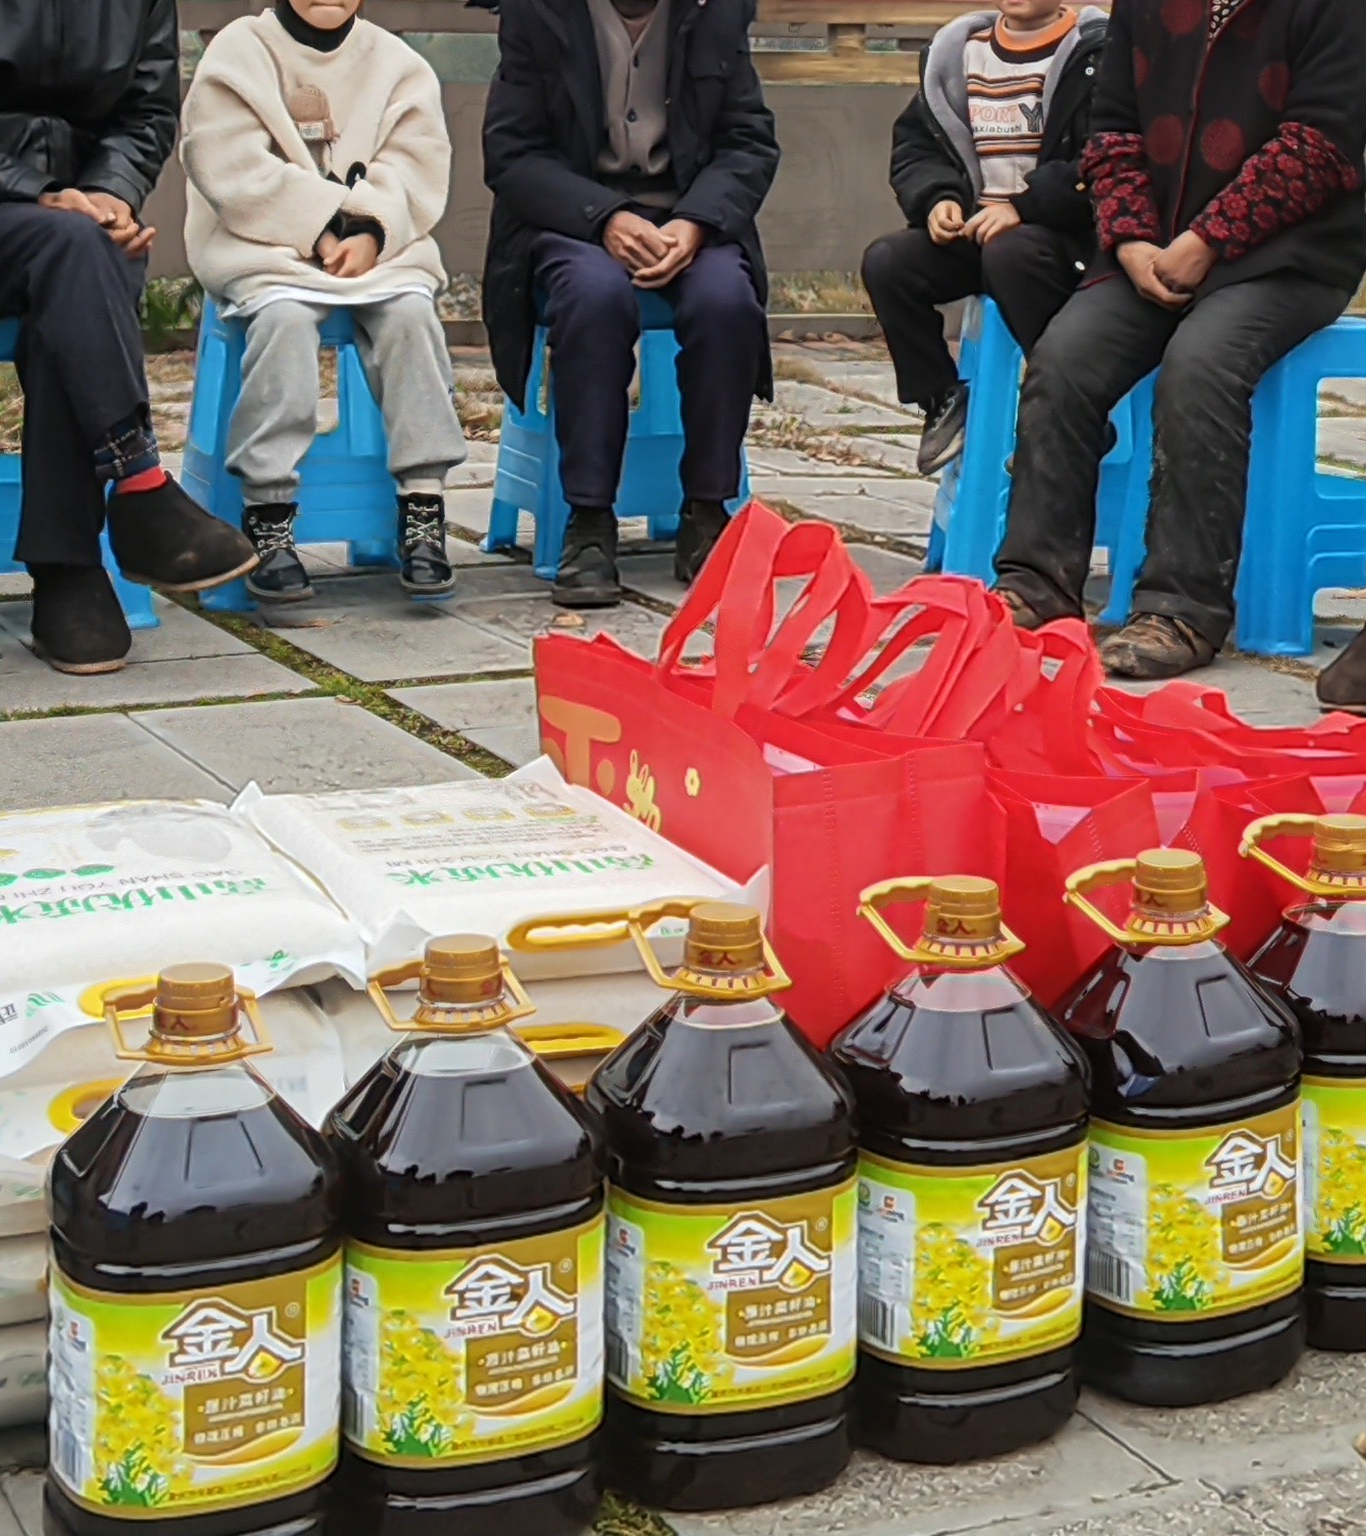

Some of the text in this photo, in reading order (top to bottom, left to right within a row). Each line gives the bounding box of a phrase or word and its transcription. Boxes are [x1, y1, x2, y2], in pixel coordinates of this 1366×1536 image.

[969, 104, 1018, 123] PORT
[1206, 1135, 1297, 1192] 金人
[978, 1176, 1077, 1239] 金人
[1205, 1190, 1248, 1205] JINREN
[707, 1217, 832, 1283] 金人
[976, 1233, 1022, 1248] JINREN
[446, 1260, 576, 1328] 金人
[707, 1277, 759, 1292] JINREN
[162, 1301, 304, 1374] 金人
